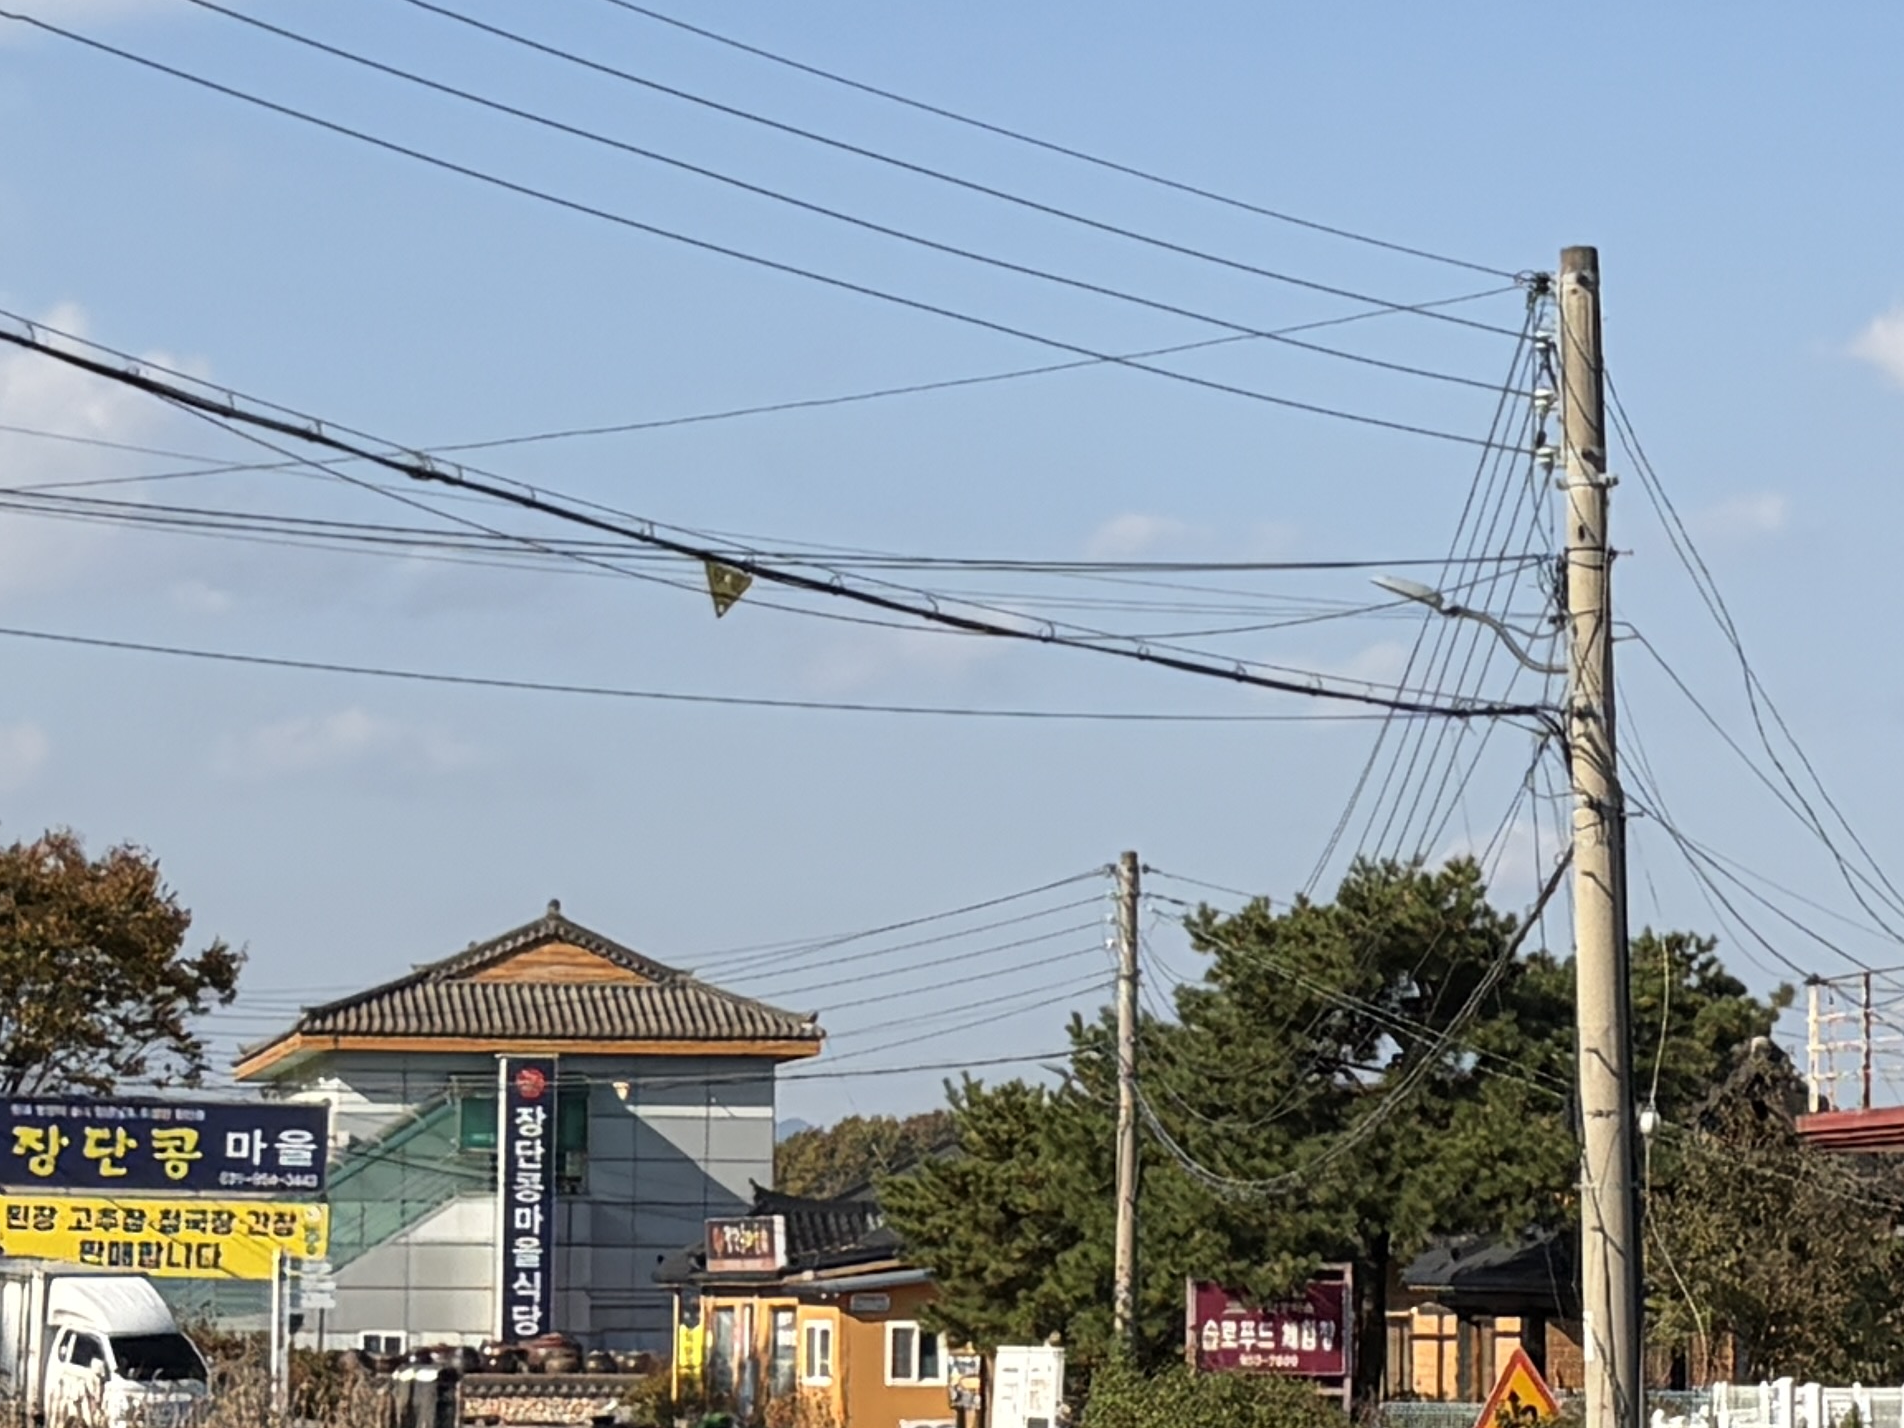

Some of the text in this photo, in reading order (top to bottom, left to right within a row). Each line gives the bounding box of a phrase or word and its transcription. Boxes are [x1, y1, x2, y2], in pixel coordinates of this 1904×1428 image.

[225, 1128, 319, 1167] 마을
[7, 1203, 59, 1232] 된장
[247, 1209, 298, 1237] 간장
[512, 1105, 547, 1336] 장단콩마을식당
[79, 1239, 222, 1270] 판매합니다
